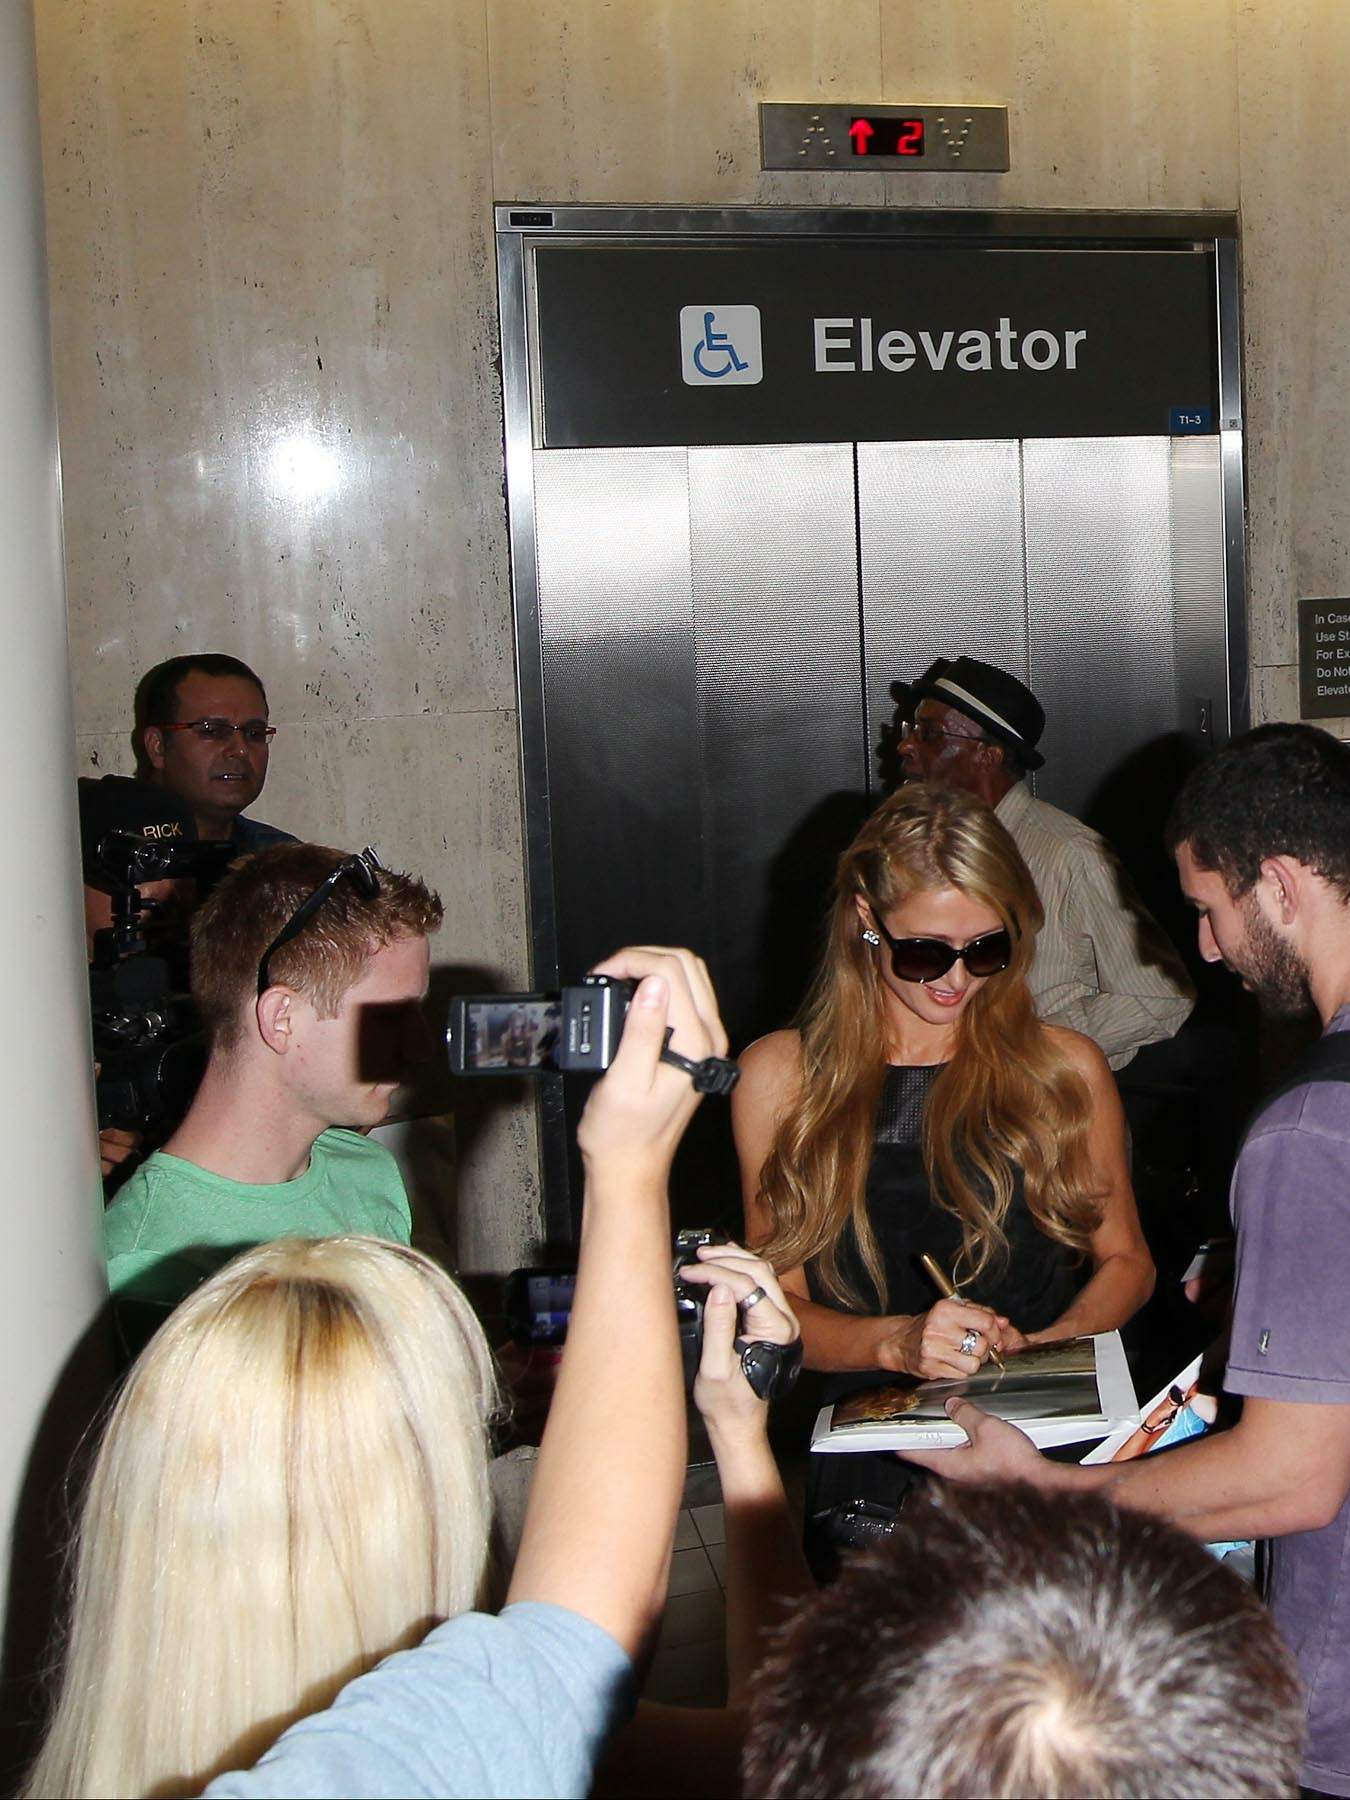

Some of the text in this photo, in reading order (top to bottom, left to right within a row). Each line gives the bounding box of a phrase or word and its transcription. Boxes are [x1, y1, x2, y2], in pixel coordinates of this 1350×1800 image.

[896, 121, 924, 154] 2
[813, 317, 1087, 372] Elevator
[1315, 613, 1325, 625] In
[1315, 631, 1336, 643] Use
[1316, 649, 1334, 660] For
[1316, 667, 1332, 678] Do
[143, 822, 183, 839] RICK
